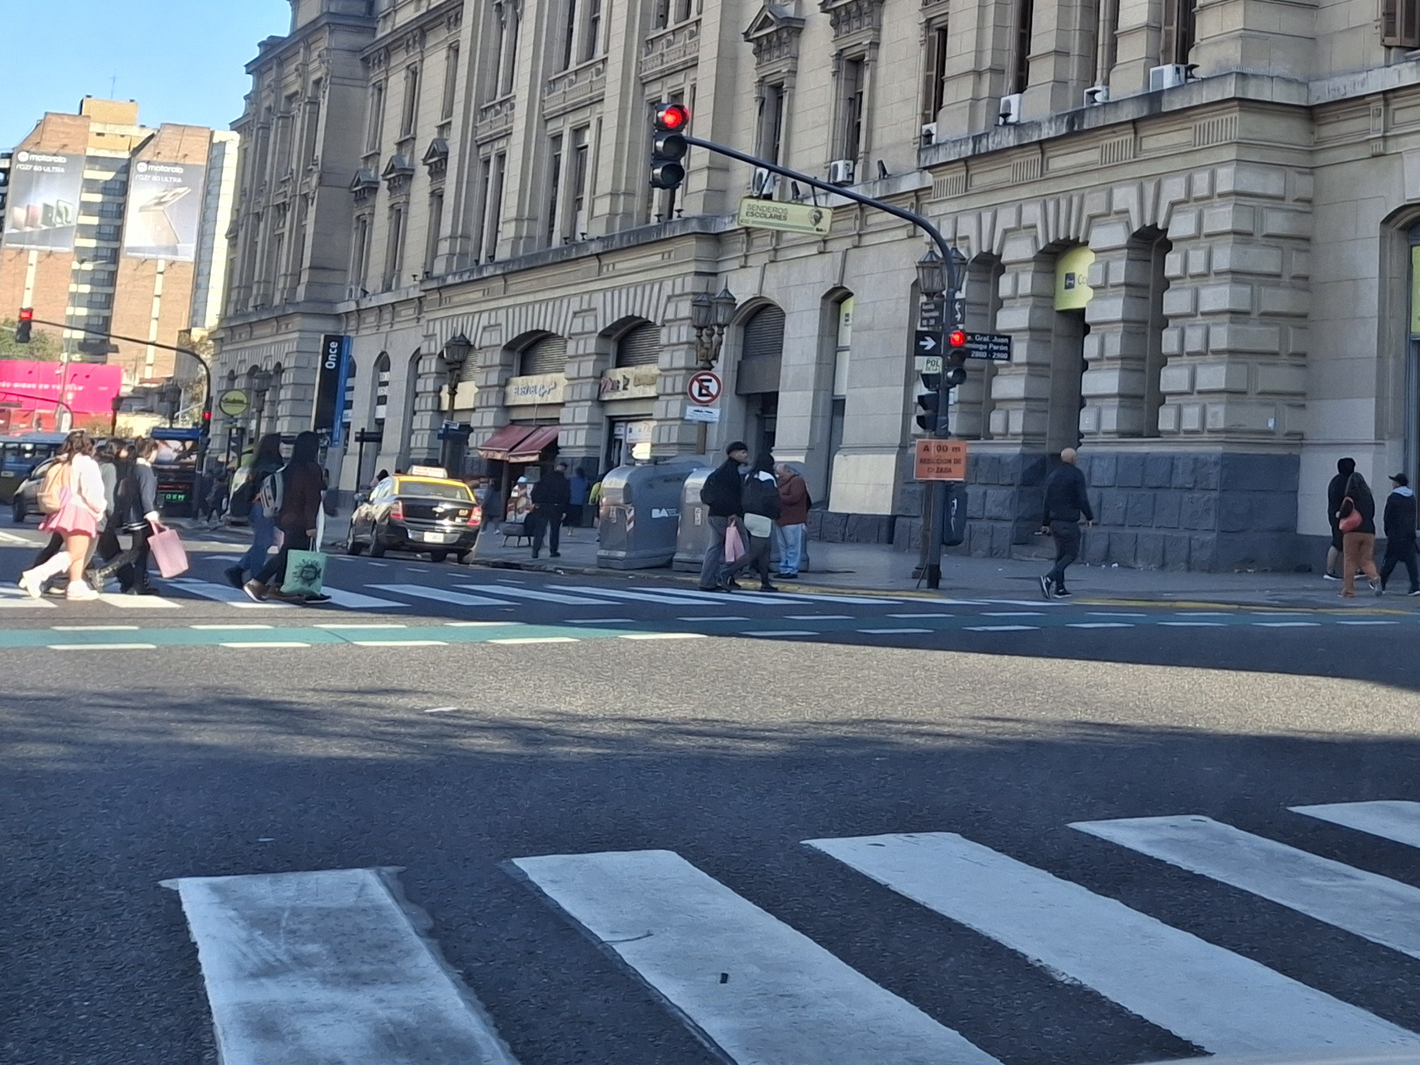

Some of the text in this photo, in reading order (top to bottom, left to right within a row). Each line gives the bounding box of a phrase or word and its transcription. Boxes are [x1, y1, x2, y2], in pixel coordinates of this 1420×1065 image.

[29, 154, 67, 164] motorola
[148, 164, 184, 174] motorola
[746, 203, 788, 215] SENDEROS
[746, 211, 788, 221] ESCOLARES
[992, 335, 1009, 343] Juan
[325, 341, 338, 369] Once
[651, 508, 669, 519] BA
